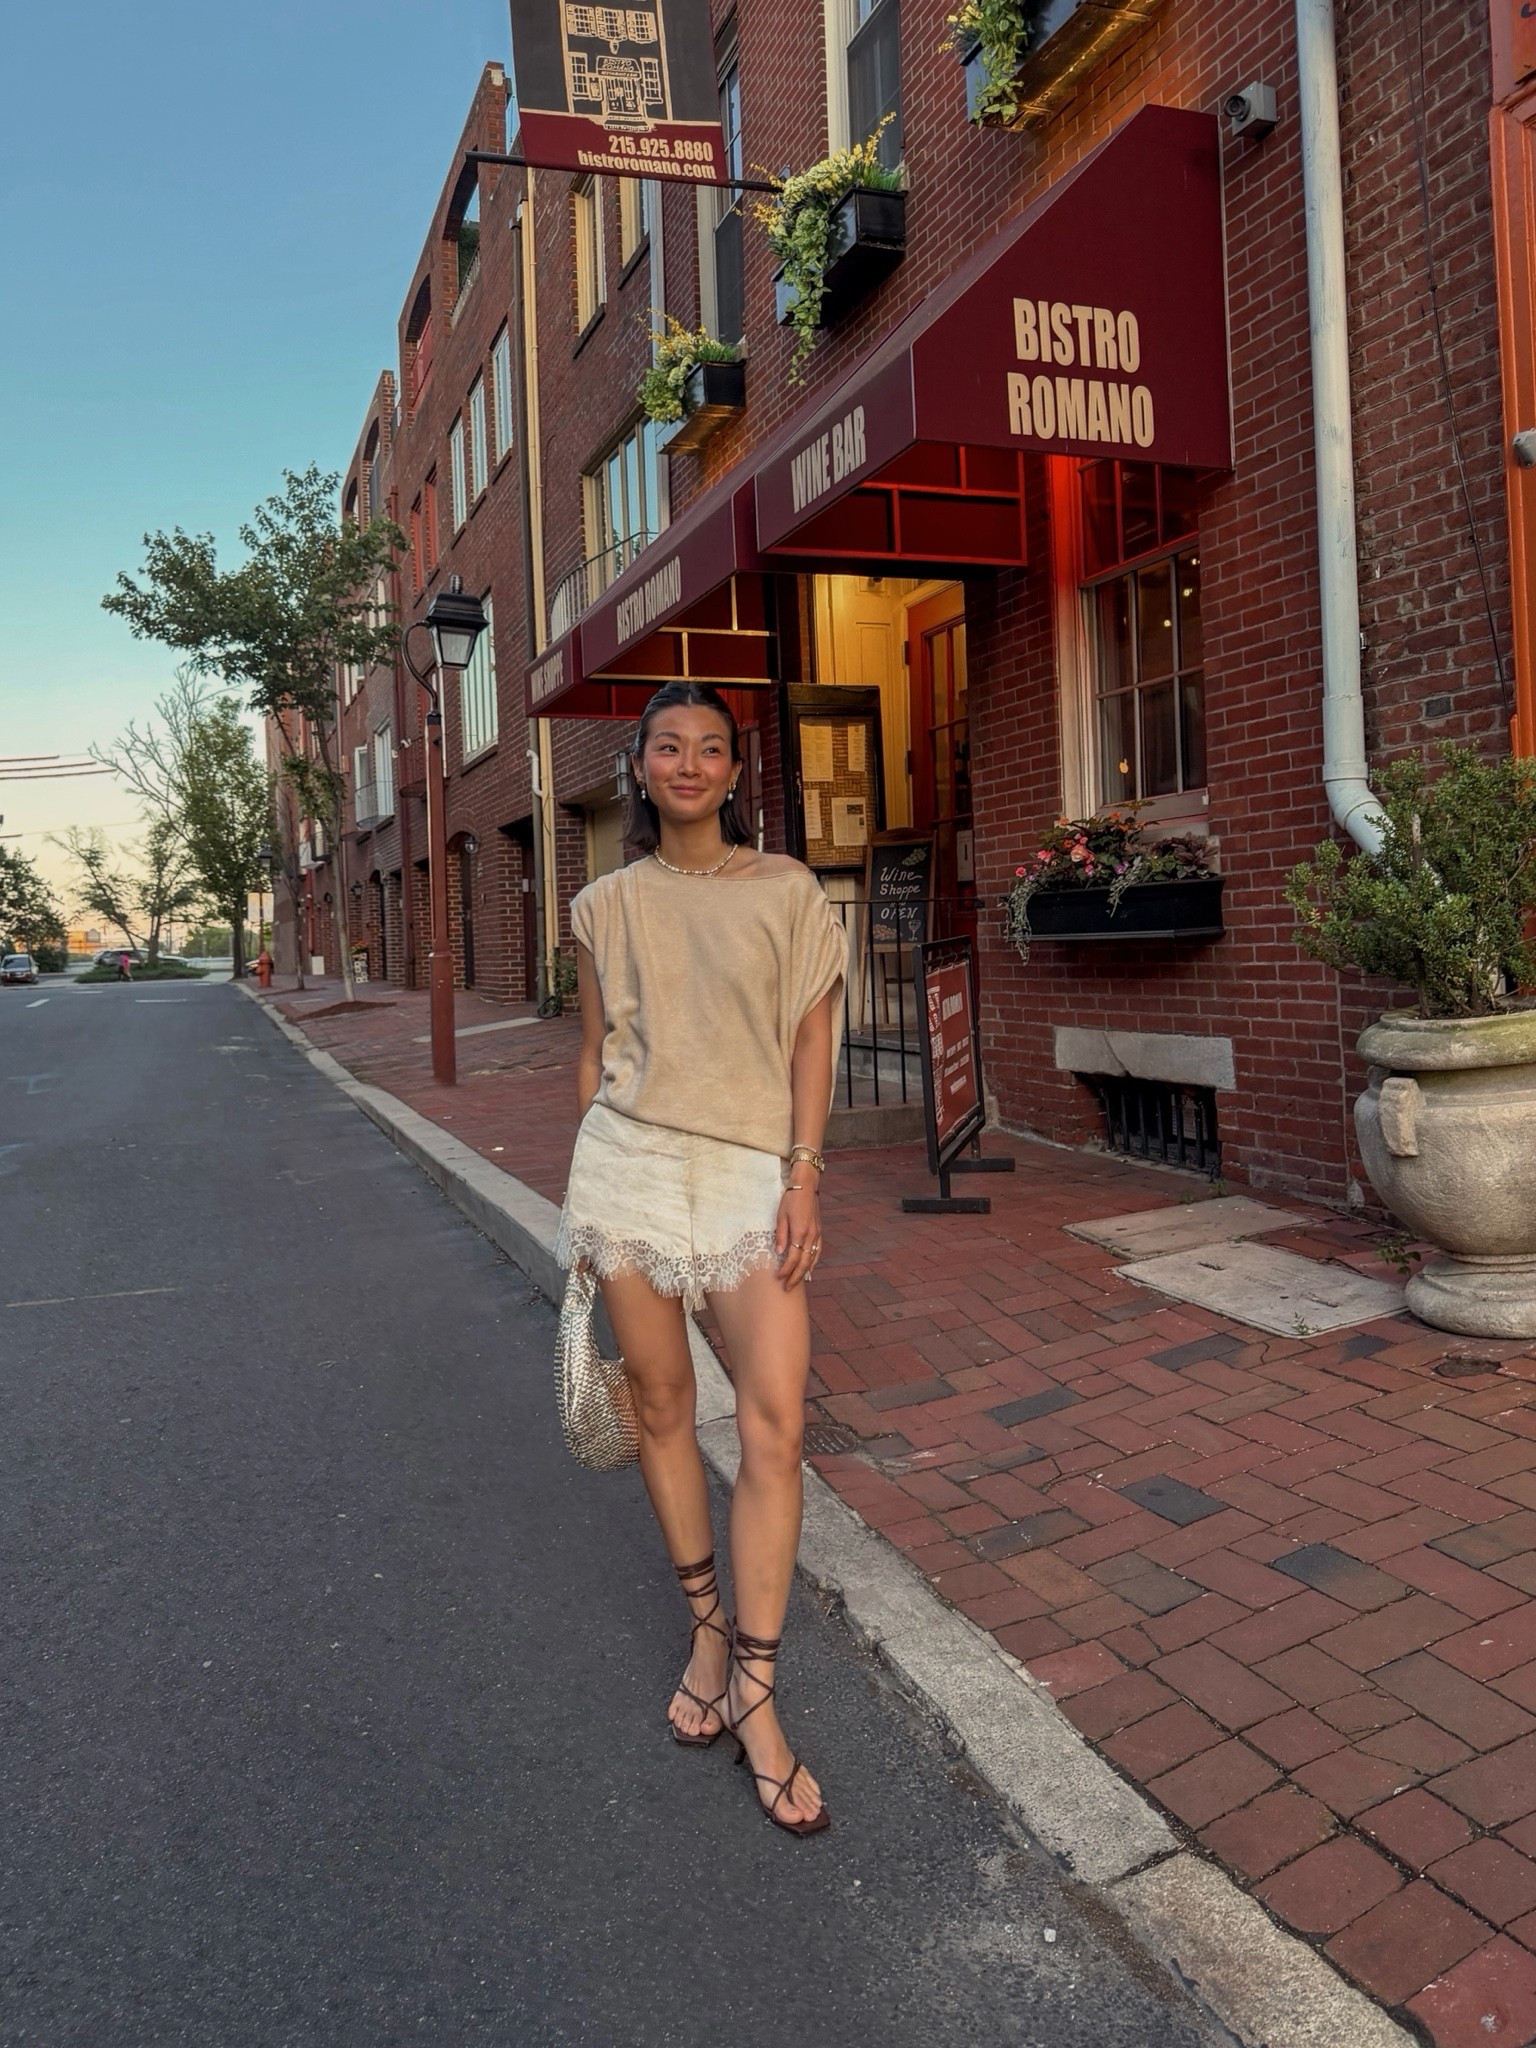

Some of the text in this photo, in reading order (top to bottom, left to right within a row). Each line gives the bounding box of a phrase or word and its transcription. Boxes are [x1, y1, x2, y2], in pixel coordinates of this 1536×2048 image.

[577, 150, 717, 179] bistroromano.com
[608, 135, 714, 162] 215.925.8880
[1013, 297, 1141, 374] BISTRO
[1007, 371, 1155, 448] ROMANO
[791, 405, 867, 514] WINE BAR
[616, 555, 682, 646] BISTRO ROMANO
[879, 883, 921, 900] Shoppe
[880, 866, 924, 882] Wine
